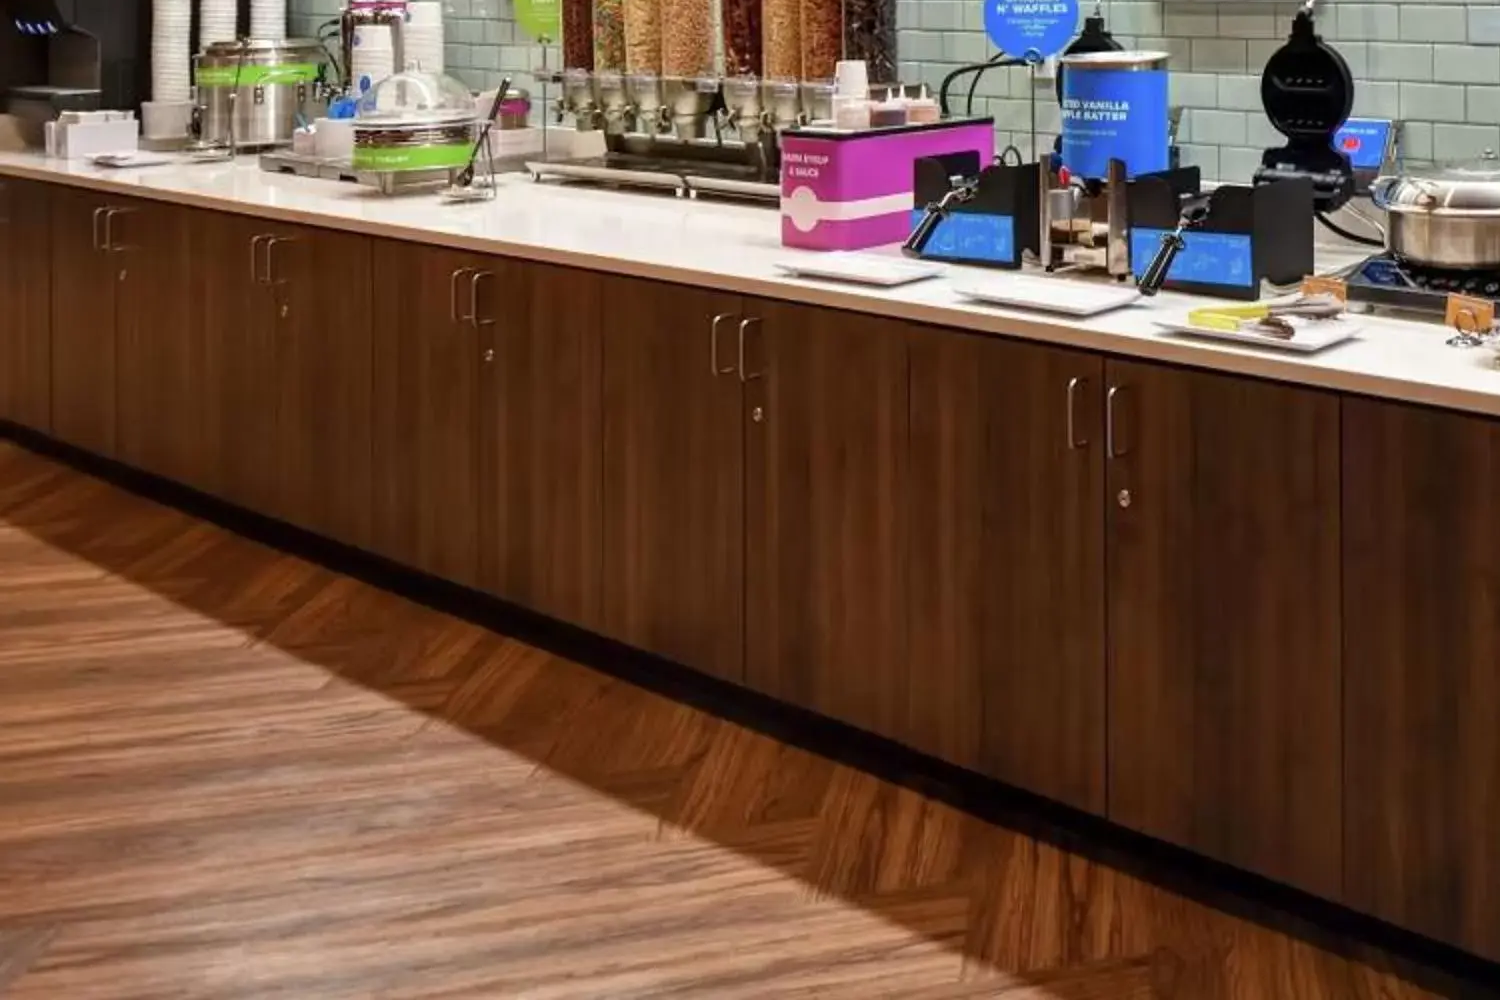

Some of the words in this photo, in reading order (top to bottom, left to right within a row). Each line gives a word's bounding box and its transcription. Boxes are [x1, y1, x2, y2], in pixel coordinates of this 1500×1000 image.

[1013, 3, 1068, 14] WAFFLES
[1082, 100, 1130, 111] VANILLA
[1084, 111, 1128, 121] BATTER
